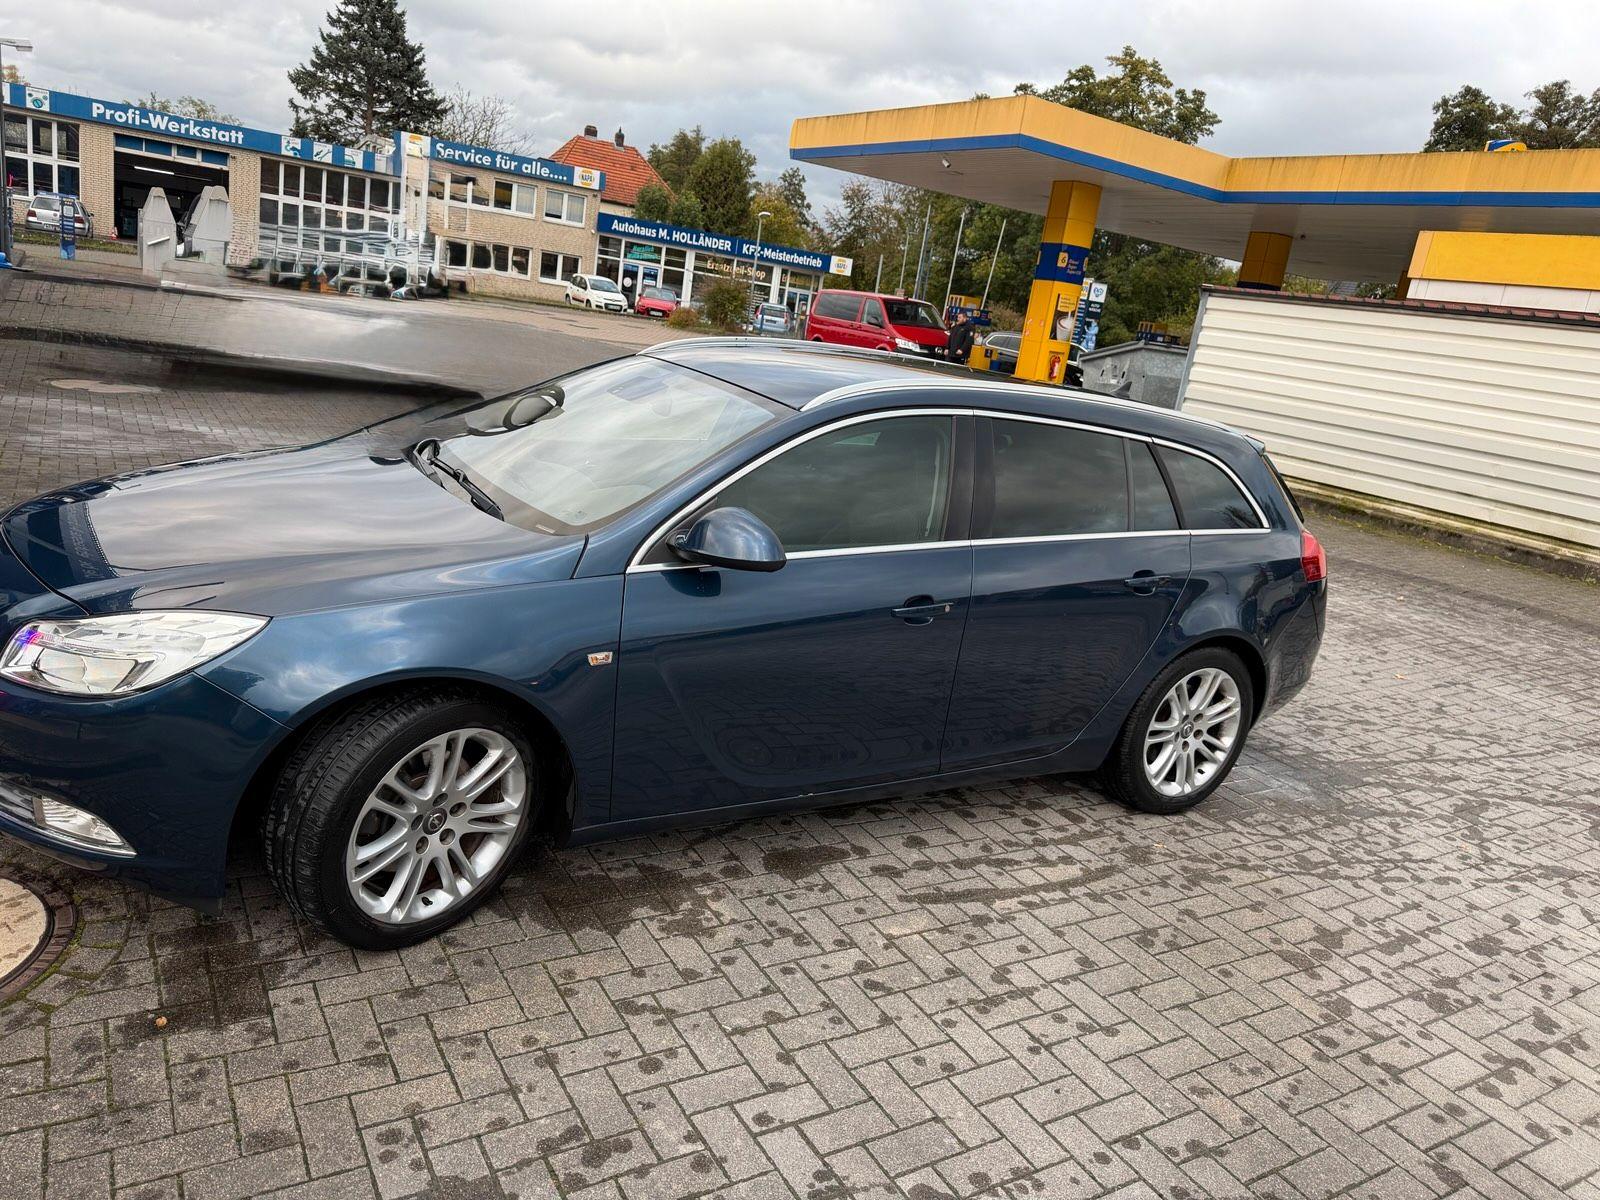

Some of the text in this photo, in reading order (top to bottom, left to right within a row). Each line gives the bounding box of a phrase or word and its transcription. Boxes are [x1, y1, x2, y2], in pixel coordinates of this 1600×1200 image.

[91, 102, 244, 145] Profi-Werkstatt
[435, 142, 567, 181] Service für alle....
[611, 219, 732, 251] Autohaus M. HOLLÄNDER
[706, 260, 766, 280] Erstzeil-Sop
[742, 243, 822, 267] KFZ-Meisterbetrieb
